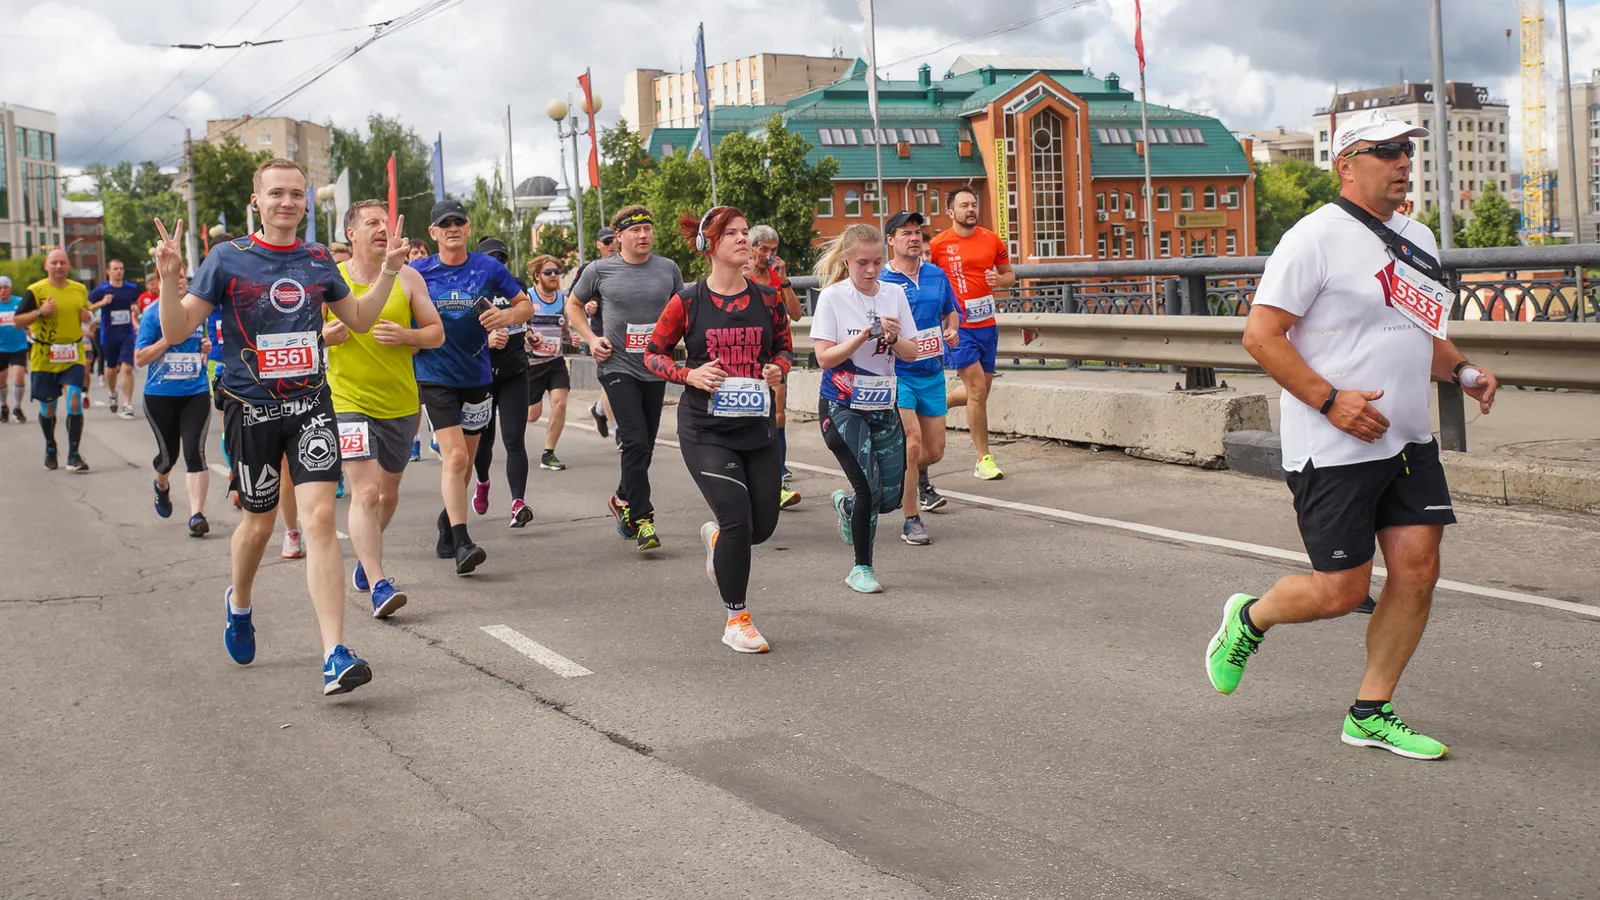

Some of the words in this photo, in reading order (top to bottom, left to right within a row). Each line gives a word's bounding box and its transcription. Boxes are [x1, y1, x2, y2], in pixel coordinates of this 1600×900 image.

[1395, 279, 1439, 320] 5533
[1435, 292, 1443, 303] C
[969, 305, 990, 317] 3378
[1383, 324, 1412, 333] ГРУППА
[301, 337, 308, 346] C
[629, 334, 651, 346] 556
[705, 327, 763, 347] SWEAT
[540, 343, 556, 352] 529
[917, 338, 938, 353] 569
[265, 348, 308, 367] 5561
[707, 346, 762, 365] TODAY
[169, 362, 194, 373] 3516
[755, 383, 761, 391] B
[884, 380, 890, 388] C
[717, 392, 762, 407] 3500
[856, 388, 889, 402] 3777
[463, 410, 488, 423] 3482
